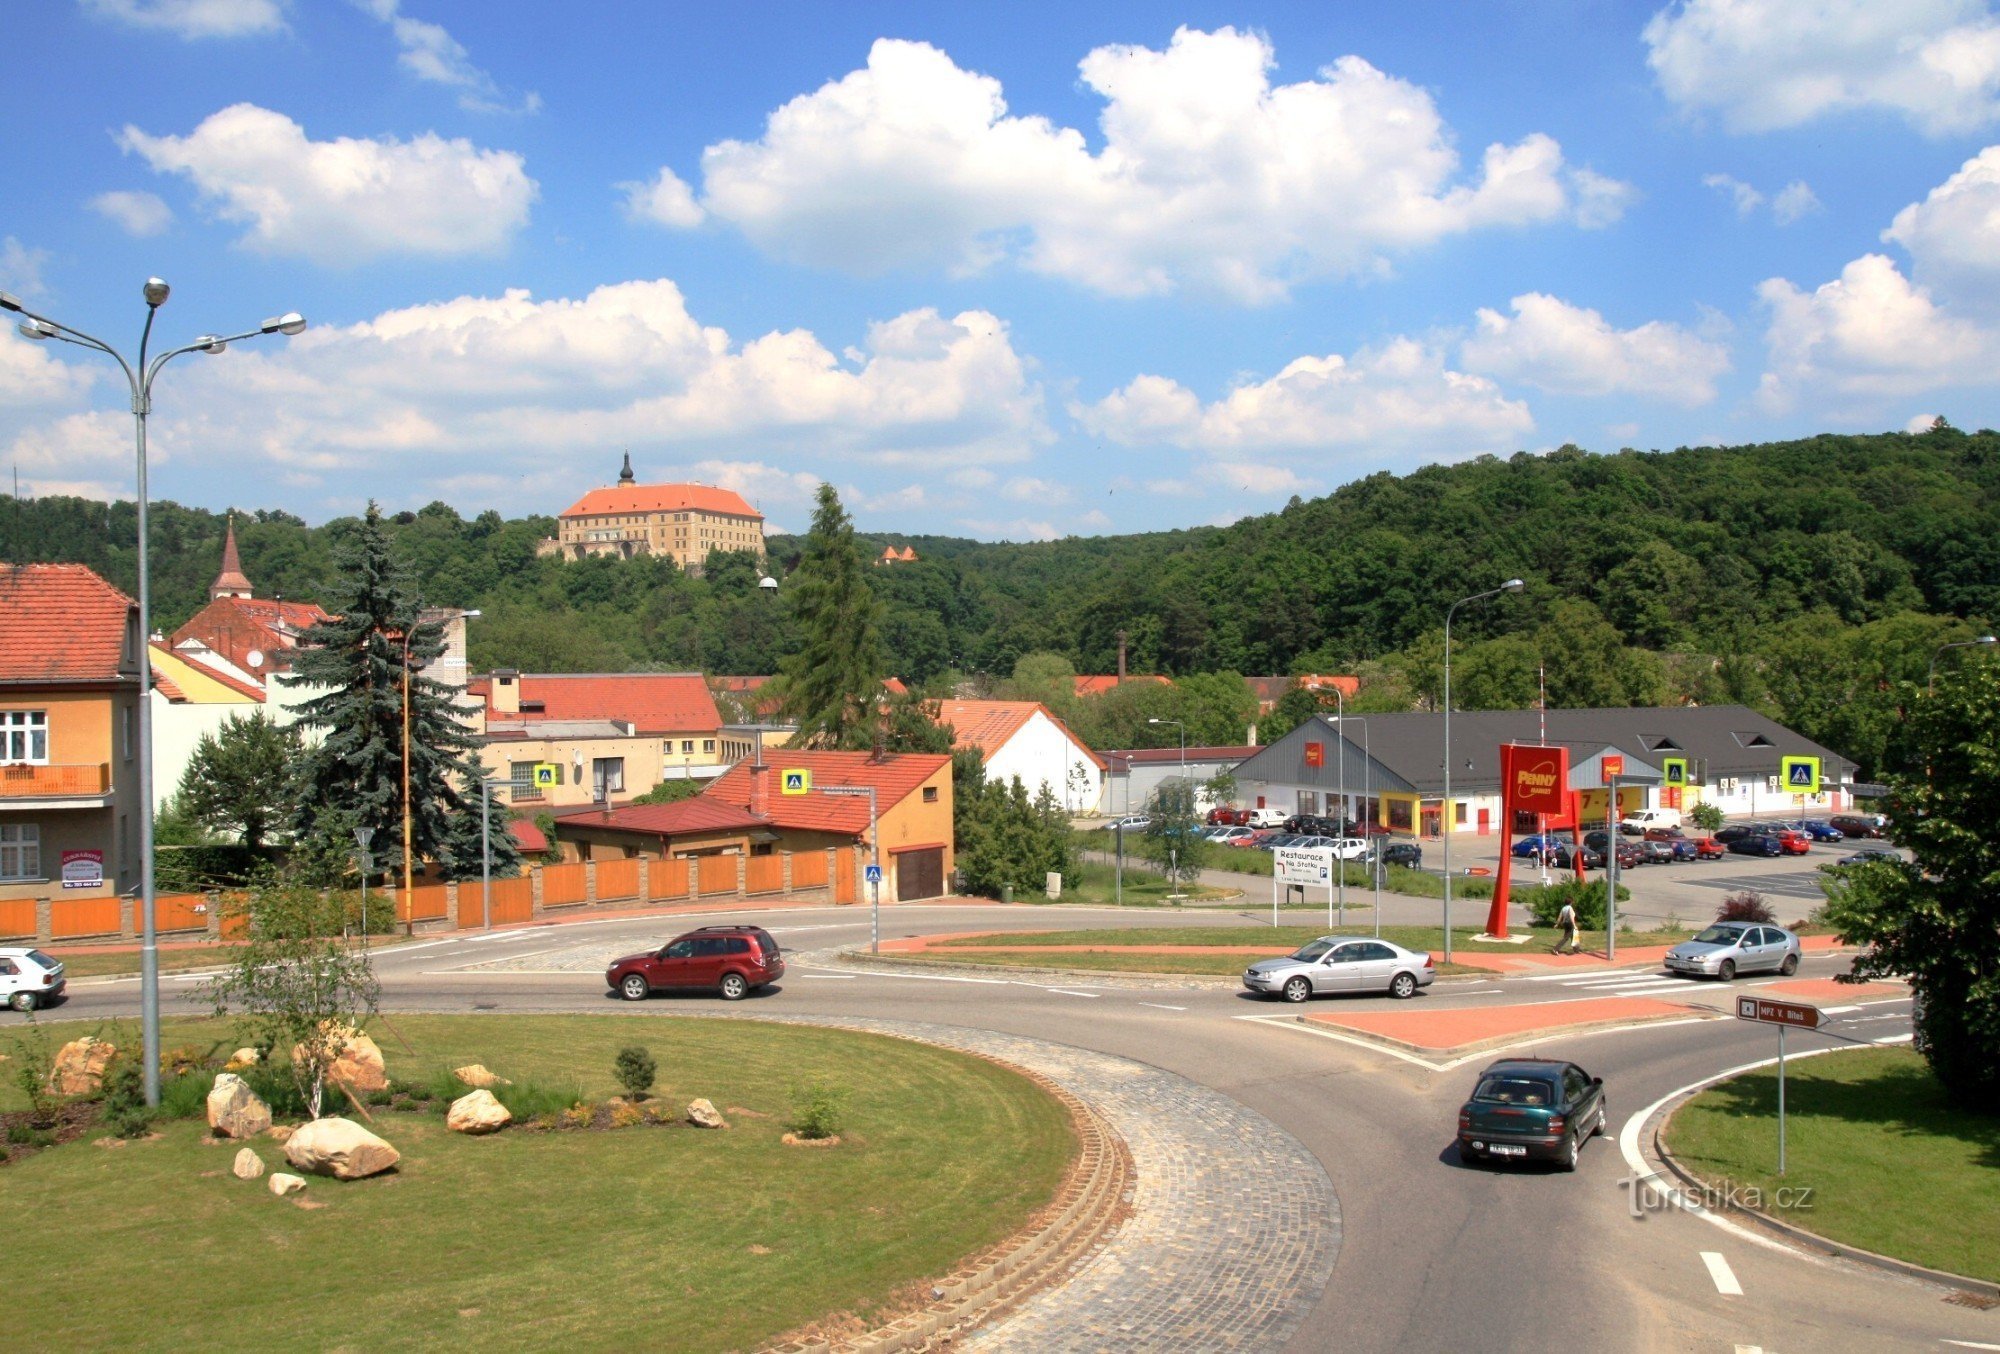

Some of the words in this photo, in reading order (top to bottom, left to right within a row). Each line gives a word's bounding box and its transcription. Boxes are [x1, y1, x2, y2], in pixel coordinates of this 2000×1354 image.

[1517, 770, 1557, 787] PENNY
[1530, 787, 1551, 795] MARKET
[1582, 794, 1592, 809] 7
[1280, 850, 1324, 861] Restaurace
[1761, 1006, 1774, 1017] MPZ
